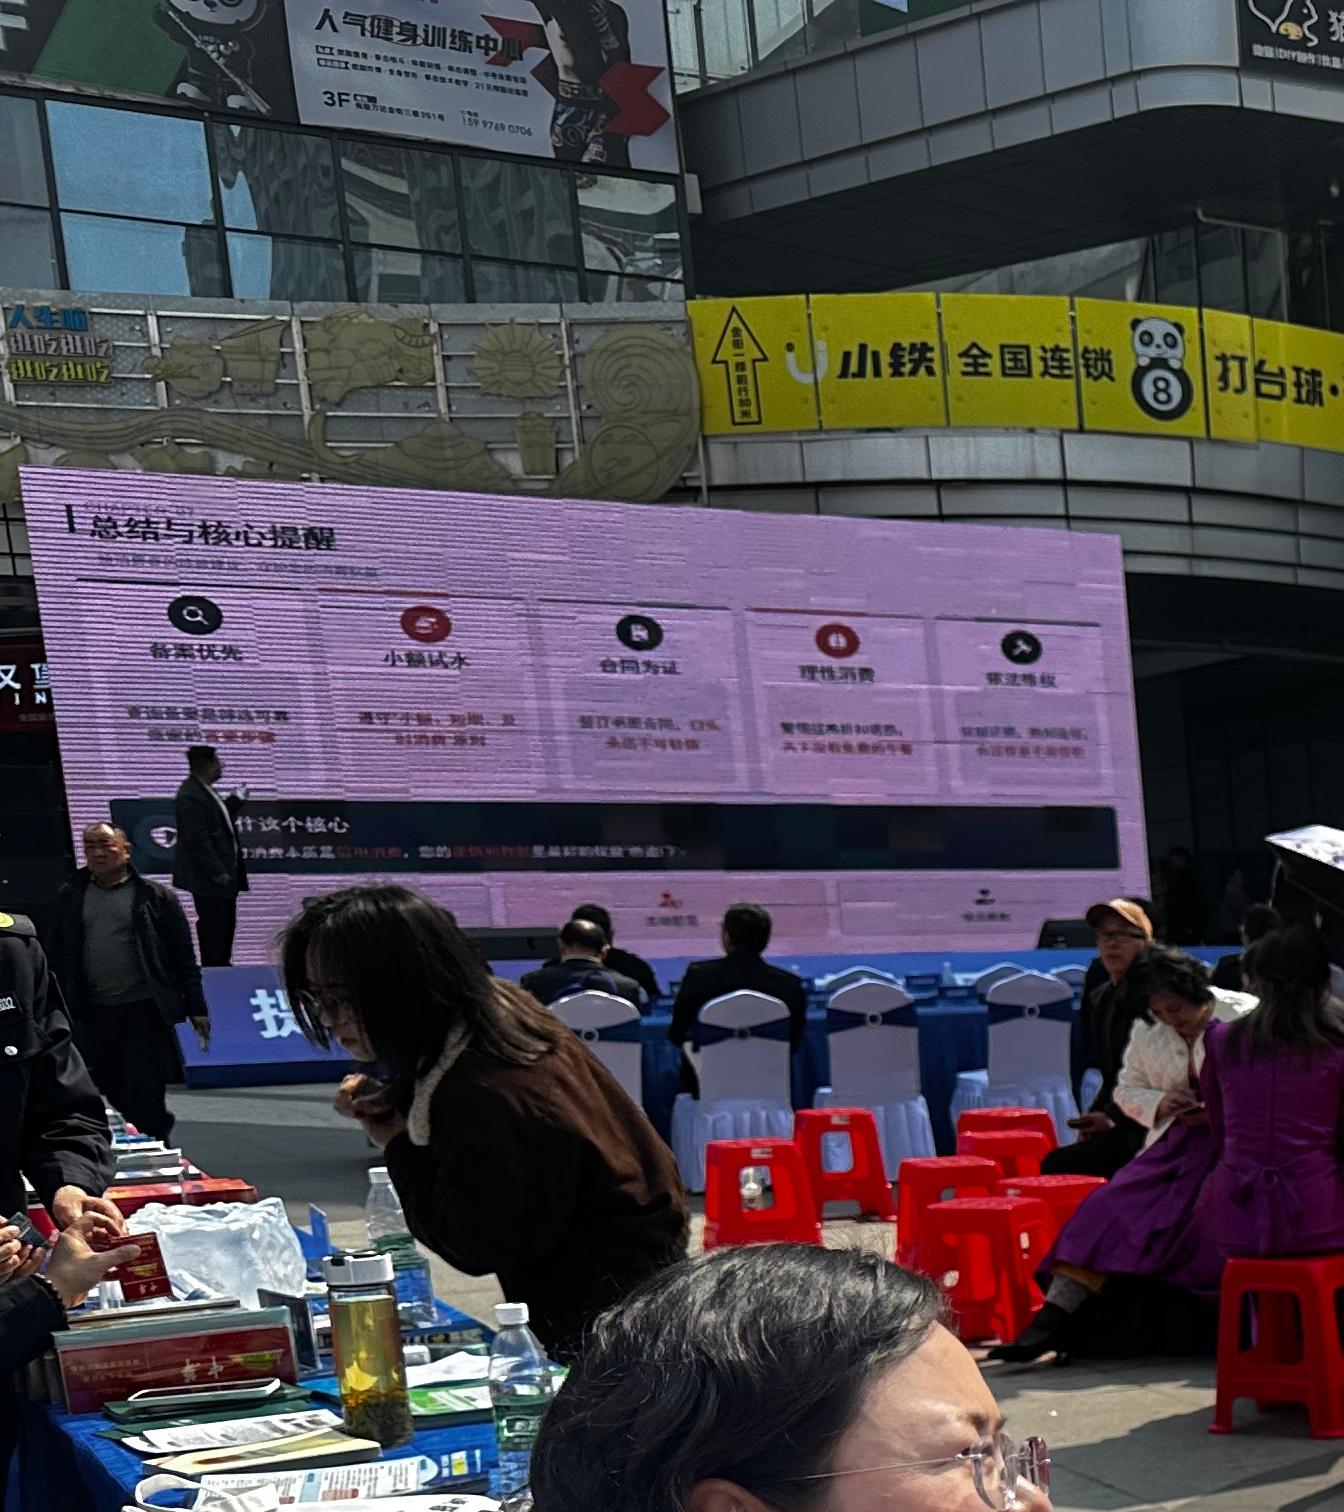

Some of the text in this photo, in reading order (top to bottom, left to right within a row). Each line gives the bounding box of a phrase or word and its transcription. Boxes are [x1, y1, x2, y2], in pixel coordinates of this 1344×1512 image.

[315, 8, 525, 61] 人气健身训练中心
[322, 90, 350, 107] 3F
[837, 340, 1116, 383] 小铁 全国连锁
[1152, 376, 1172, 404] 8
[89, 514, 337, 551] 总结与核心提醒
[799, 664, 876, 683] 理性消费
